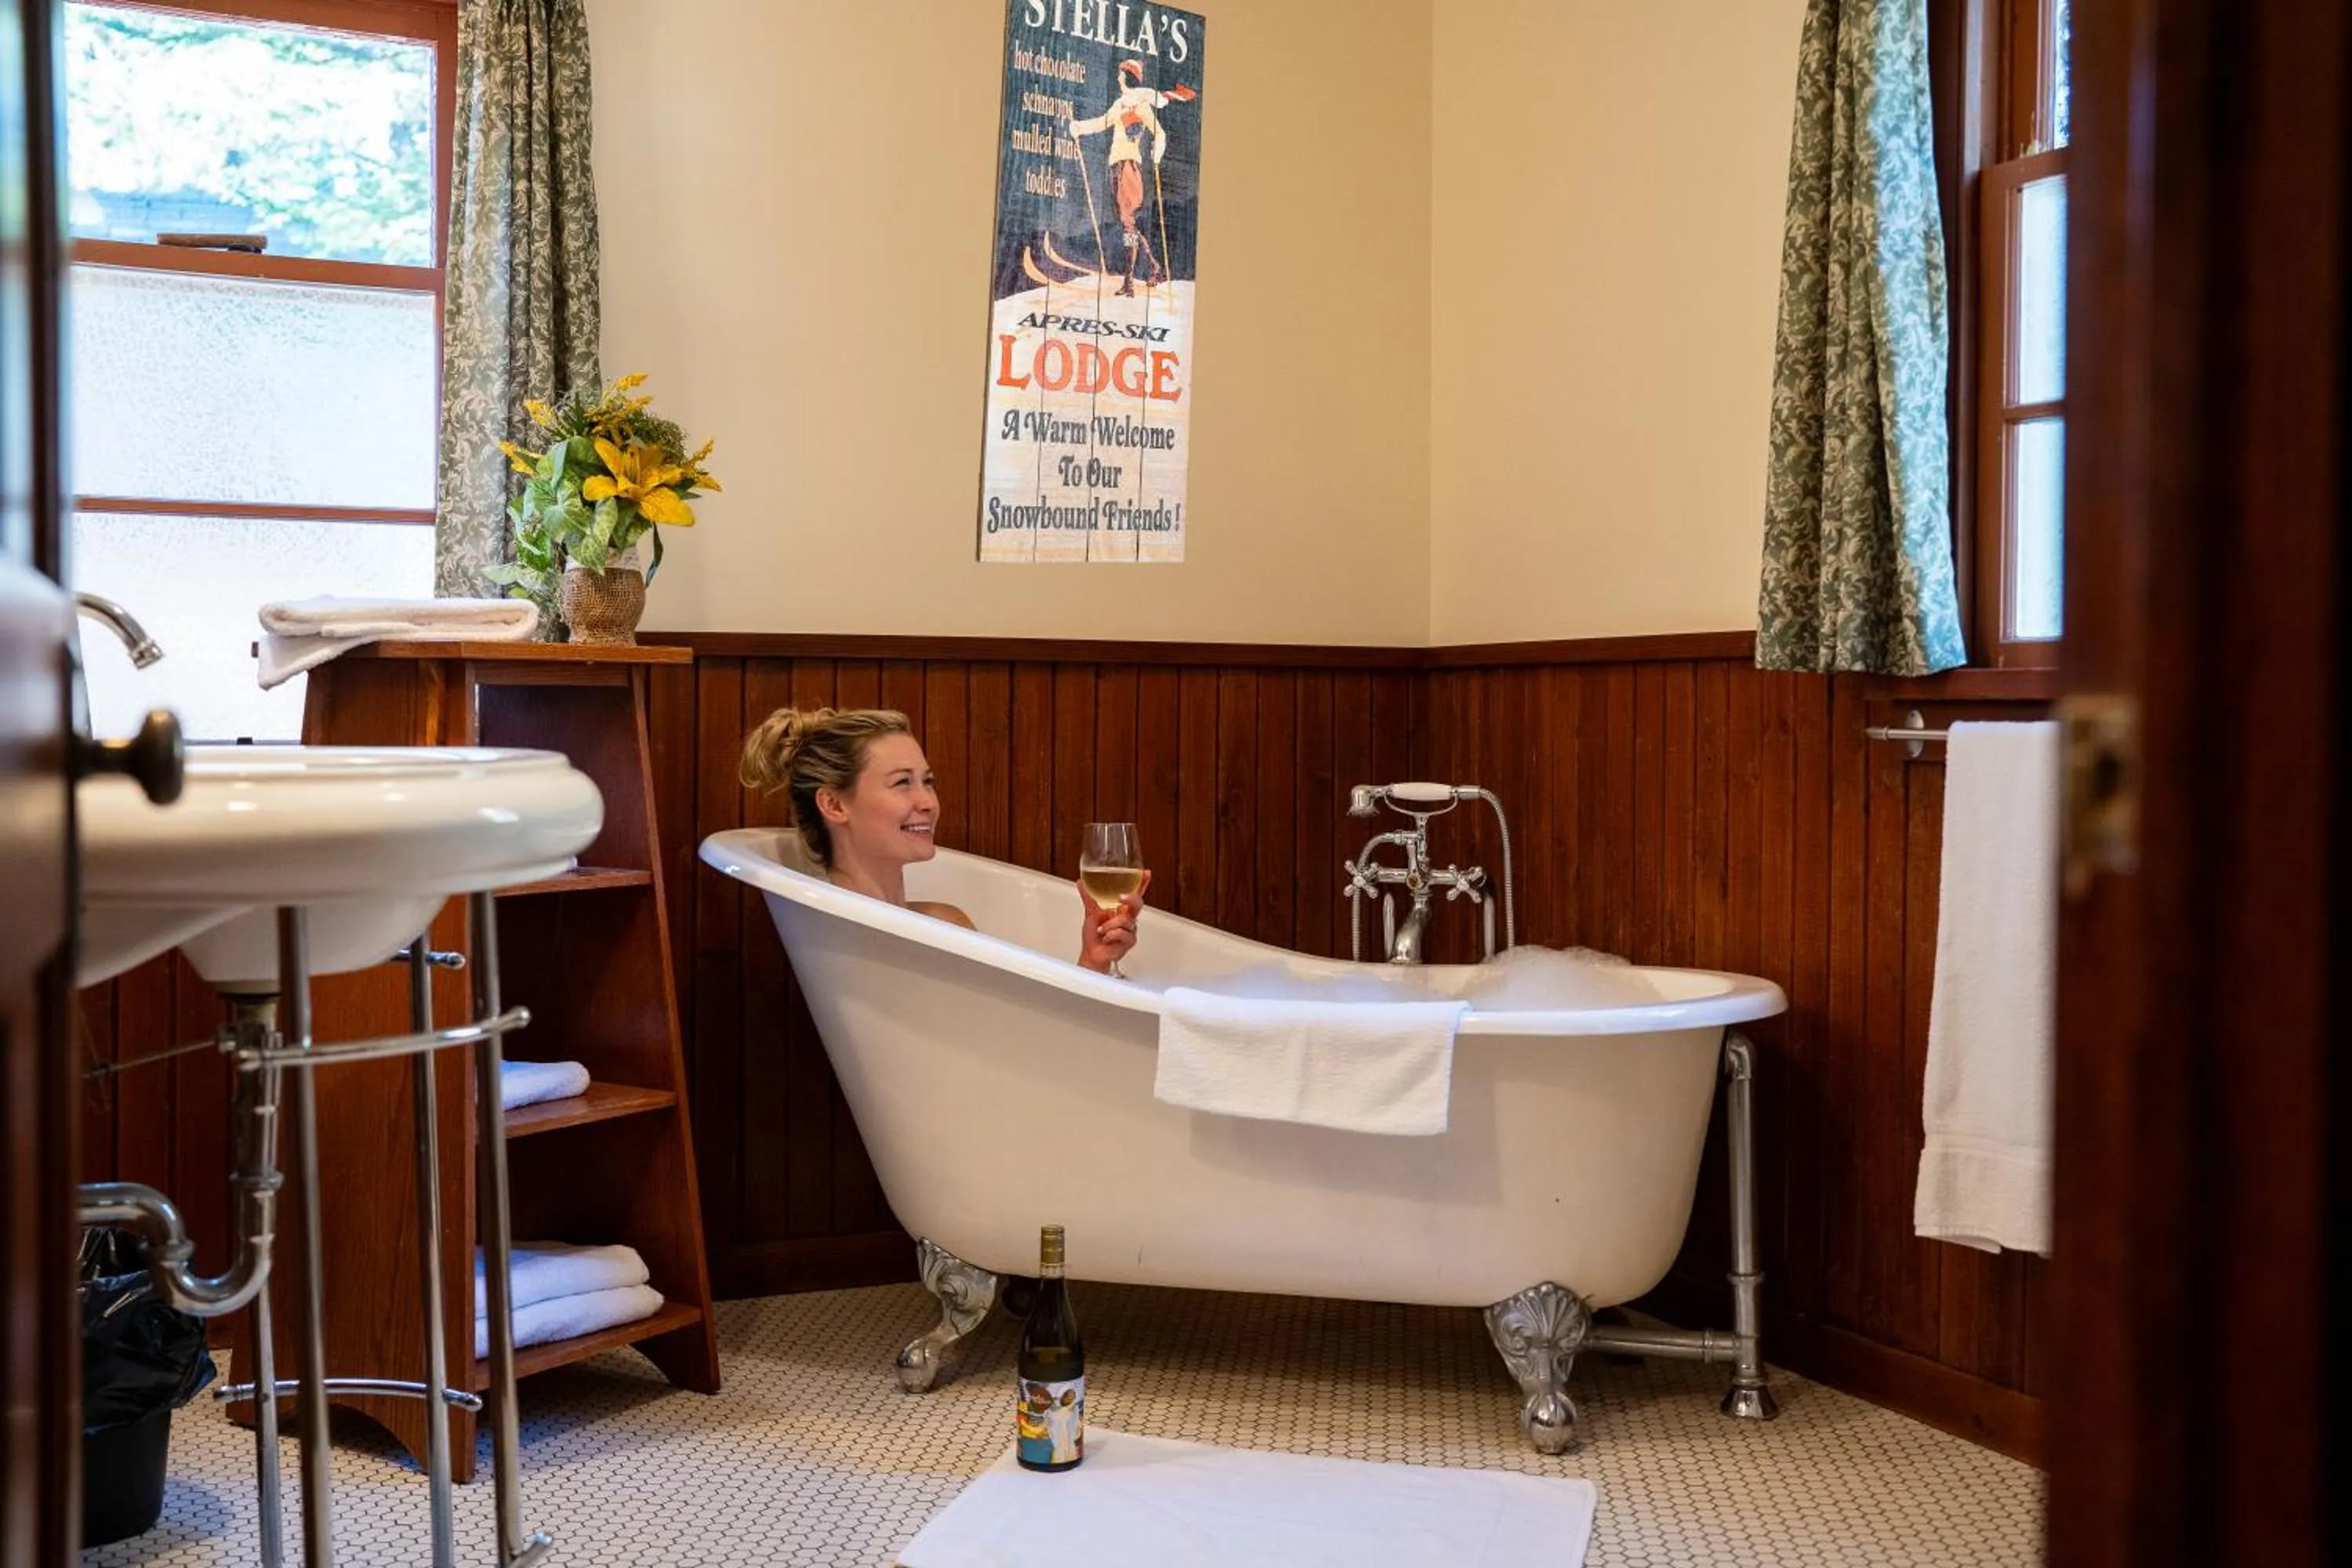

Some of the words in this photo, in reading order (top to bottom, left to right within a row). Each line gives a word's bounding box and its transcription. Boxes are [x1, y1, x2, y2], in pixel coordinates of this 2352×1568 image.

[1025, 0, 1189, 64] STELLA'S
[1014, 40, 1033, 72] hot
[1034, 45, 1086, 83] chocolate
[1022, 84, 1074, 126] schnapps
[1012, 123, 1052, 155] mulled
[1018, 313, 1171, 343] APRES-SKI
[996, 334, 1182, 401] LODGE
[1002, 409, 1021, 441] A
[1024, 412, 1087, 445] Warm
[1091, 416, 1175, 450] Welcome
[1058, 456, 1082, 488] To
[1087, 458, 1123, 489] Our
[987, 495, 1100, 534] Snowbound
[1102, 499, 1181, 532] Friends!
